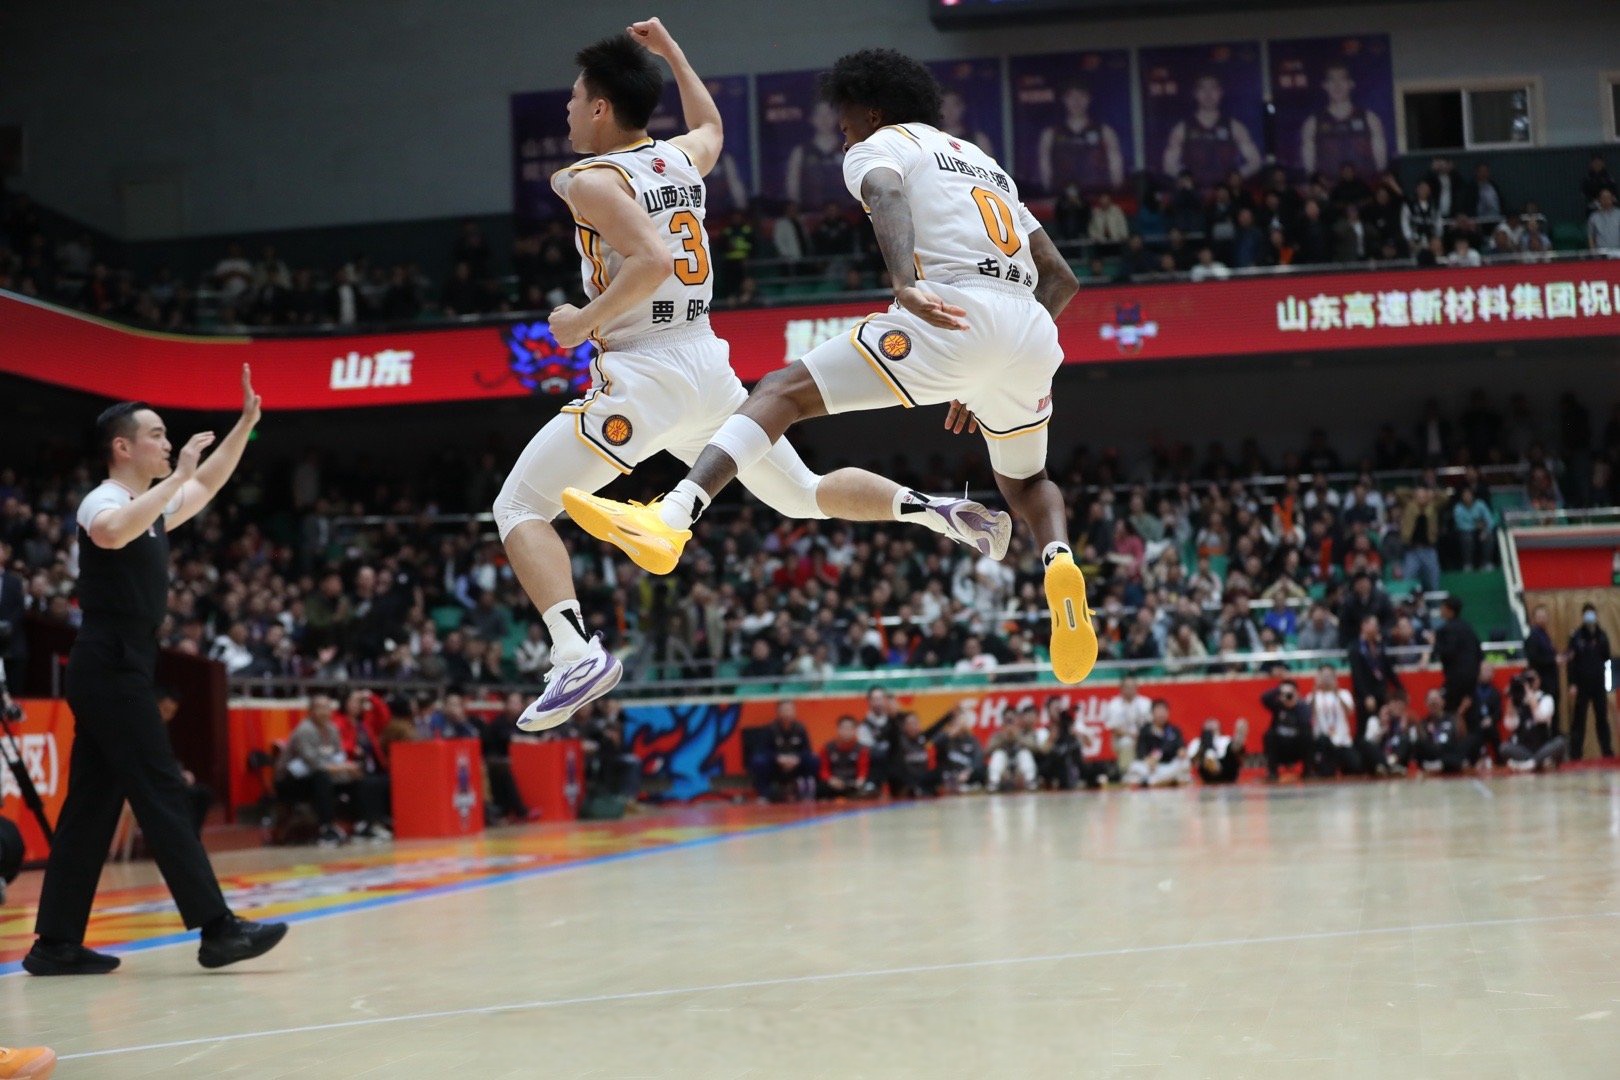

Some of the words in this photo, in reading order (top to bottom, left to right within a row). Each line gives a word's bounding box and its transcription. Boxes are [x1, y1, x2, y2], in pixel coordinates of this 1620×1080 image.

[934, 152, 1010, 193] 山西汾酒
[643, 185, 702, 214] 山西汾酒
[970, 186, 1022, 257] 0
[668, 210, 710, 286] 3
[652, 299, 710, 324] 贾明
[330, 348, 414, 391] 山东
